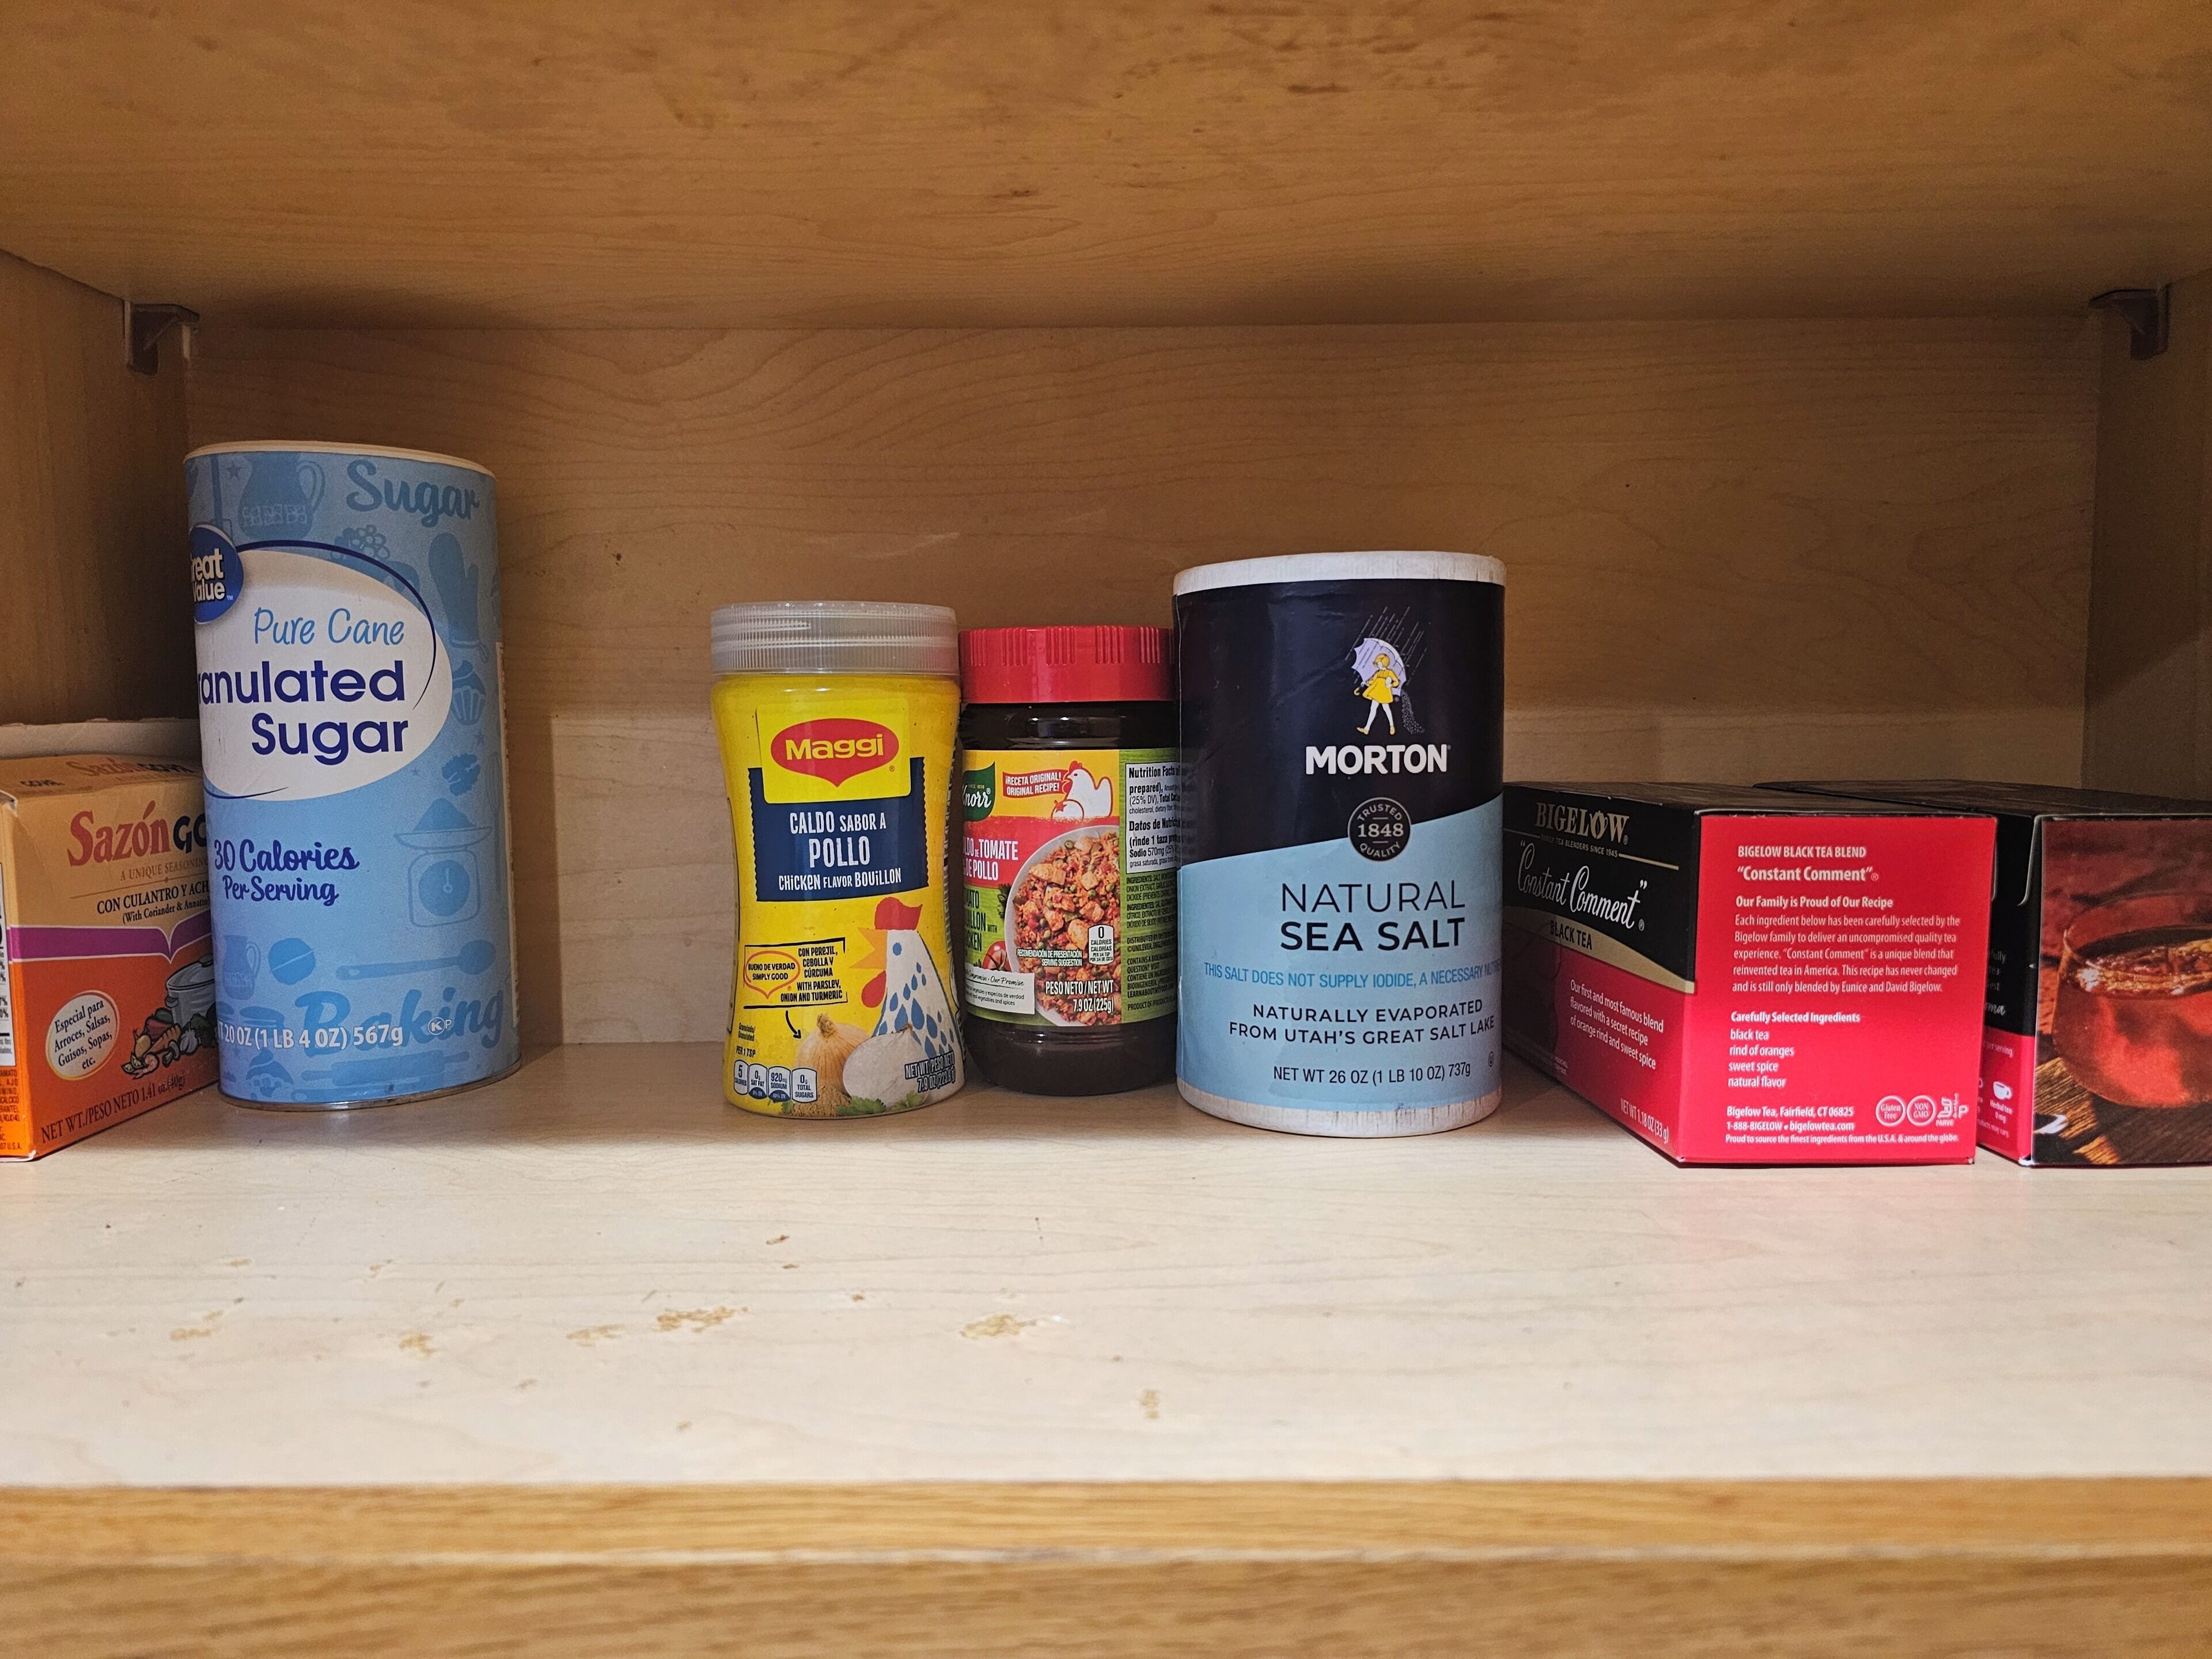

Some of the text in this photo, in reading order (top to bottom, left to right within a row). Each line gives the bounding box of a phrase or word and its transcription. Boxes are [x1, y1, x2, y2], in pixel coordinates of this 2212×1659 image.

[346, 459, 480, 527] Sugar
[191, 548, 224, 581] reat
[253, 607, 404, 646] Pure Cane
[198, 660, 405, 704] ranulated
[251, 712, 409, 766] Sugar
[785, 733, 884, 760] Maggi
[1305, 744, 1447, 775] MORTON
[1029, 772, 1061, 784] ORIGINAL!
[1129, 766, 1161, 778] Nutrition
[963, 784, 991, 808] norr
[1007, 783, 1059, 796] ORIGINAL RECIPE!
[790, 810, 887, 834] CALDO SABOR A
[1357, 804, 1402, 821] TRUSTED
[1535, 802, 1630, 843] BIGELOW
[67, 800, 207, 867] Sazón GO
[1129, 819, 1160, 831] Datos de
[1358, 823, 1404, 838] 1848
[214, 839, 360, 873] 30 Calories
[808, 835, 870, 868] POLLO
[979, 839, 1018, 861] TOMATE
[1130, 849, 1146, 858] Sodio
[1359, 841, 1400, 858] QUALITY
[1737, 846, 1867, 858] BIGELOW BLACK TEA BLEND
[973, 859, 998, 881] POLLO
[1737, 865, 1801, 881] "Constant
[222, 874, 250, 900] Per
[251, 876, 339, 907] Serving
[823, 875, 853, 888] FLAVOR
[97, 897, 120, 914] CON
[123, 888, 179, 908] CULANTRO
[180, 885, 187, 896] Y
[1282, 880, 1465, 913] NATURAL
[1736, 895, 1893, 910] Our Family is Proud of Our Recipe
[123, 901, 183, 925] (With Coriander &
[1281, 918, 1465, 951] SEA SALT
[1550, 919, 1592, 950] BLACK TEA
[798, 948, 810, 957] CON
[829, 957, 834, 965] Y
[772, 962, 796, 970] VERDAD
[804, 968, 833, 978] CÚRCUMA
[1204, 962, 1222, 978] THIS
[1224, 967, 1249, 982] SALT
[1252, 970, 1284, 986] DOES
[1288, 973, 1315, 988] NOT
[1319, 974, 1368, 988] SUPPLY
[1373, 972, 1417, 988] IODIDE,
[1419, 972, 1427, 986] A
[1430, 965, 1483, 985] NECESSARY
[1001, 977, 1025, 986] Promise
[1046, 979, 1113, 994] PESO NETO NET WT
[798, 993, 810, 1002] AND
[1073, 999, 1082, 1012] 7.9
[1083, 998, 1093, 1012] OZ
[1094, 997, 1113, 1014] (225g)
[1570, 979, 1664, 1033] Our first and most famous blend
[55, 1000, 104, 1034] Especial para
[1253, 999, 1482, 1022] NATURALLY EVAPORATED
[1730, 1011, 1861, 1025] Carefully Selected Ingredients
[294, 987, 505, 1058] Baking
[1230, 1015, 1495, 1045] FROM UTAH'S GREAT SALT LAKE
[55, 1015, 111, 1053] Arroces, Salsas,
[224, 1024, 403, 1050] 20 OZ (1 LB 4 OZ) 567g
[1730, 1028, 1770, 1040] black tea
[58, 1031, 112, 1067] Guisos, Sopas,
[82, 1056, 96, 1070] etc.
[1274, 1061, 1471, 1086] NET WT 26 OZ (1 LB 10 OZ) 737g
[1728, 1075, 1787, 1088] natural flavor
[40, 1121, 62, 1143] NET
[112, 1089, 139, 1113] NETO
[1726, 1106, 1854, 1119] Bigelow Tea, Fairfield, CT 06825
[1880, 1104, 1901, 1112] Gluten
[1913, 1111, 1929, 1119] GMO
[1914, 1103, 1929, 1111] NON
[1726, 1120, 1855, 1133] 1-888-BIGELOW bigelowtea.com
